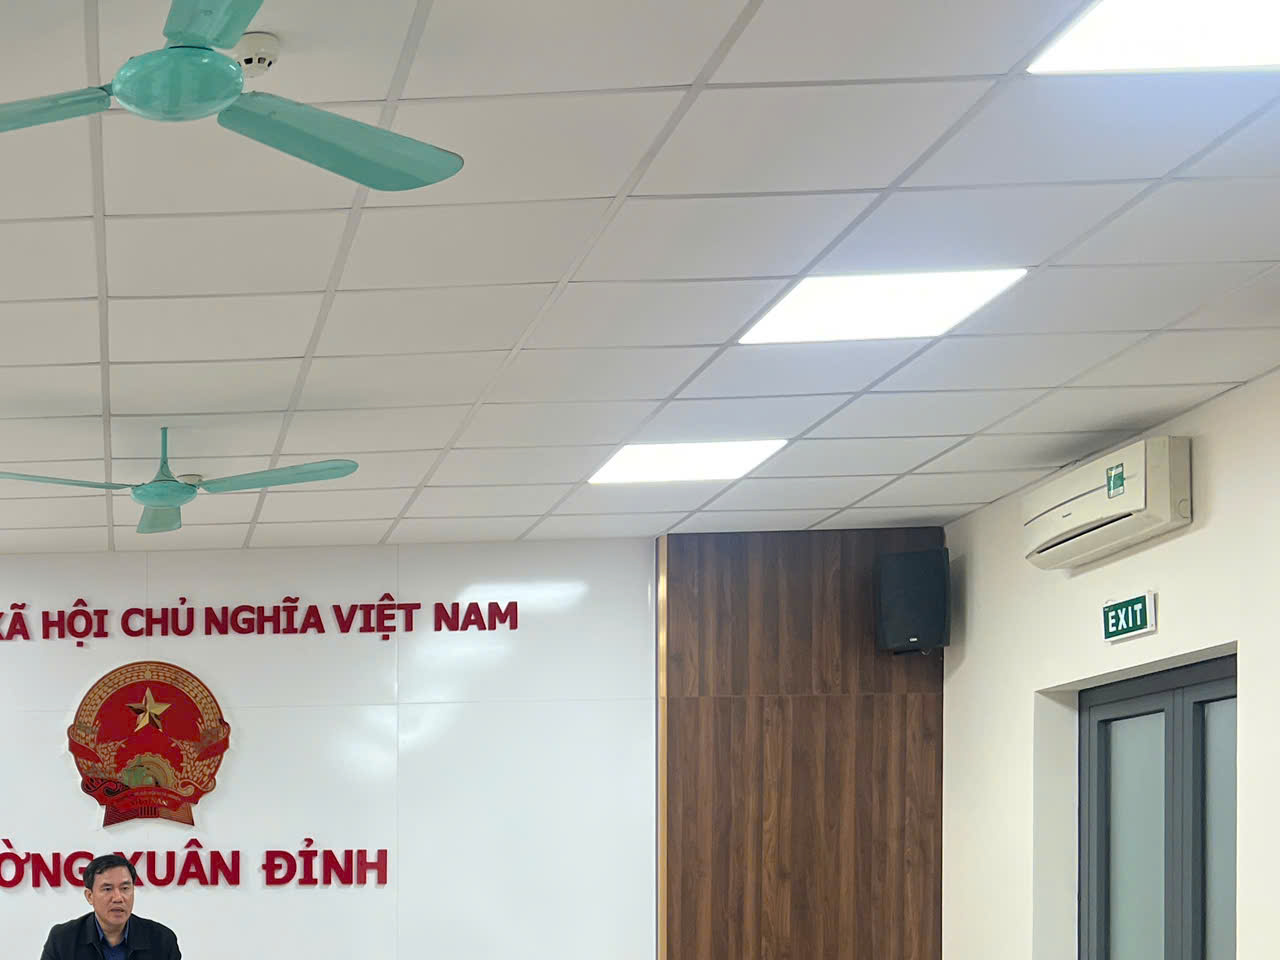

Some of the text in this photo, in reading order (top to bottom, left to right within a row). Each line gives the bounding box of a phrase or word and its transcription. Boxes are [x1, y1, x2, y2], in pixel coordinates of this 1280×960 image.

[41, 598, 109, 648] HỘI
[120, 597, 195, 637] CHỦ
[204, 596, 326, 636] NGHĨA
[333, 593, 421, 641] VIỆT
[434, 601, 519, 632] NAM
[1108, 603, 1143, 632] EXIT
[261, 838, 388, 886] ĐỈNH
